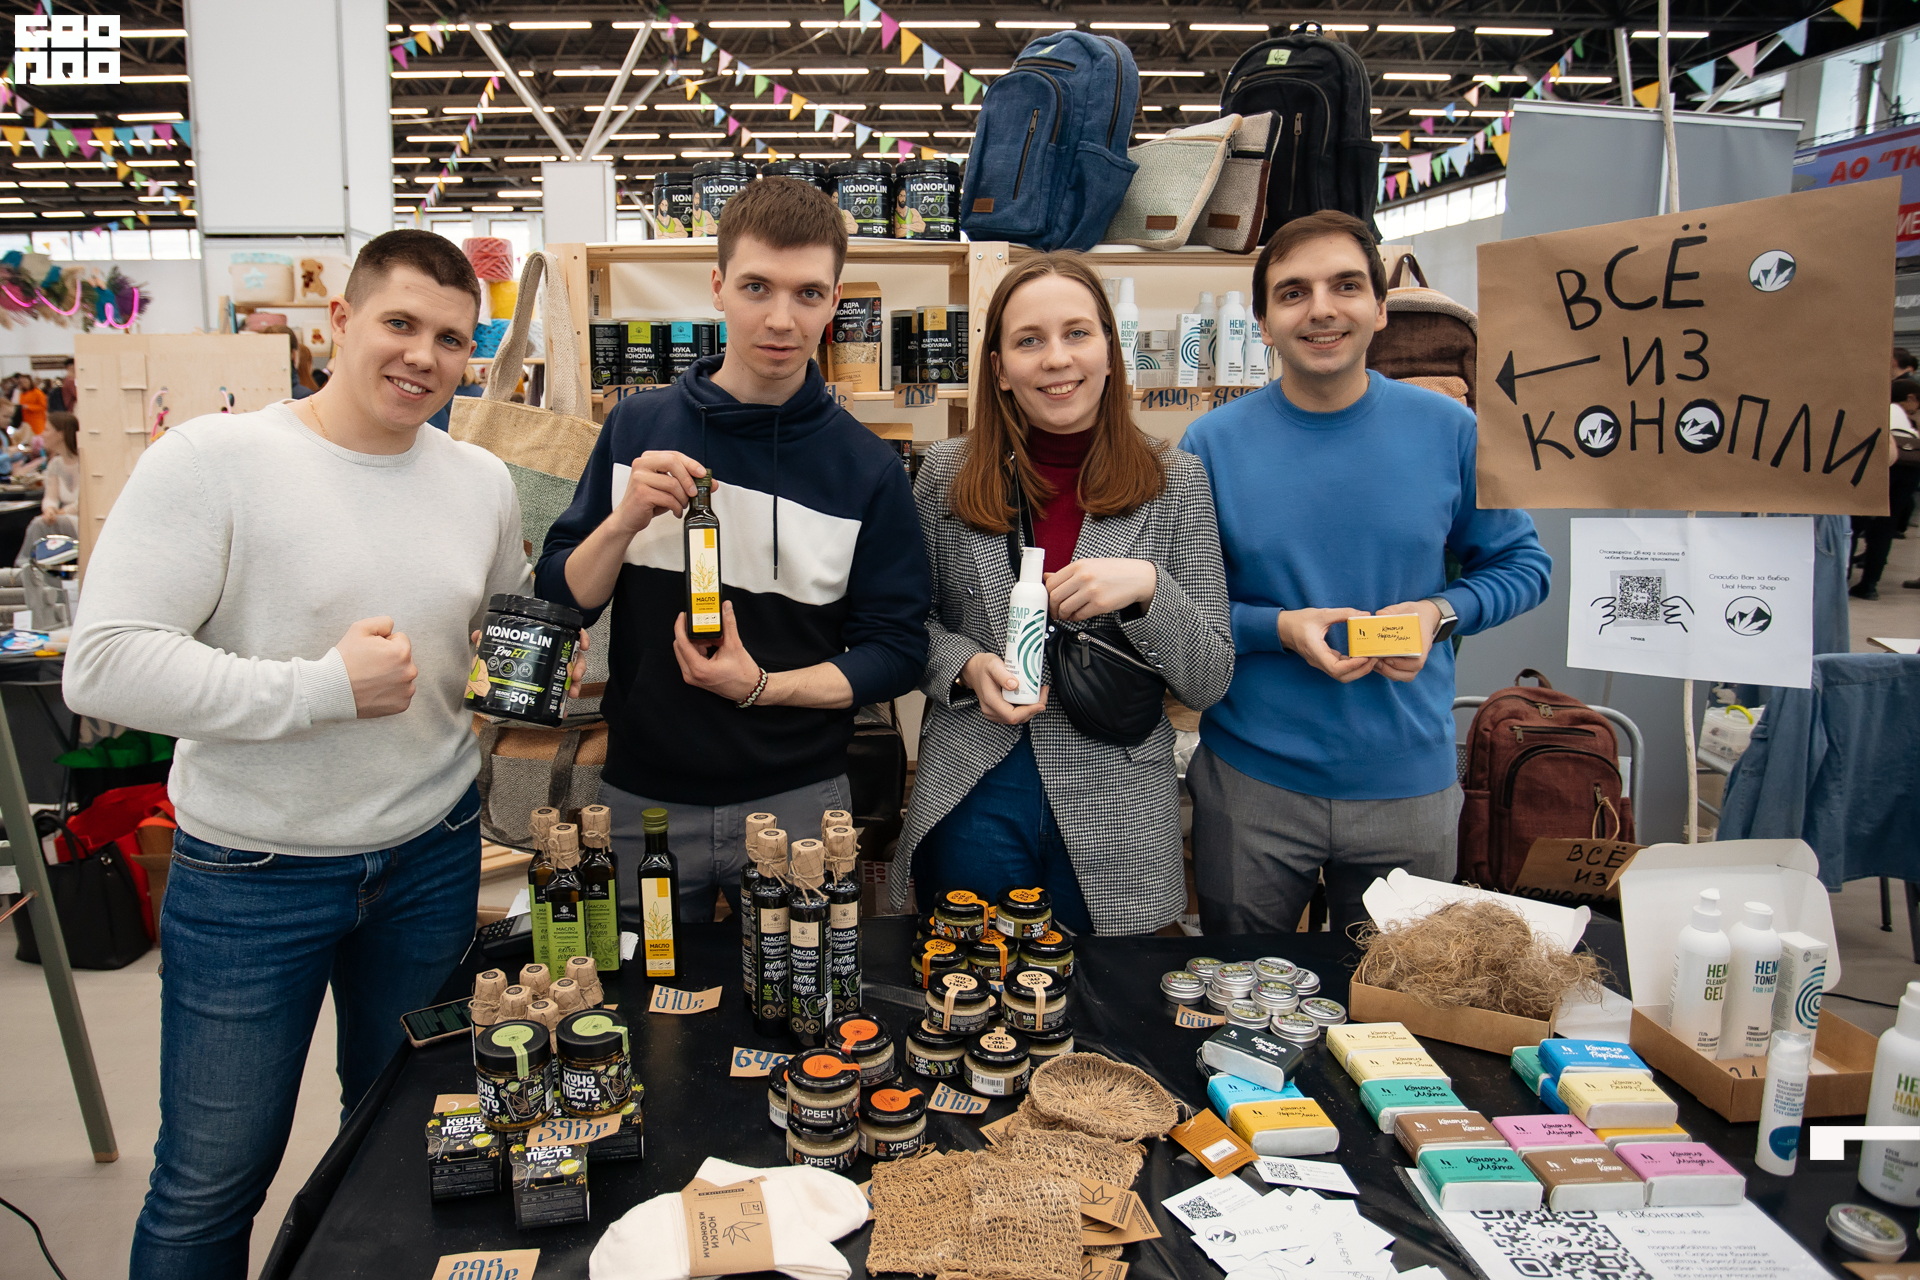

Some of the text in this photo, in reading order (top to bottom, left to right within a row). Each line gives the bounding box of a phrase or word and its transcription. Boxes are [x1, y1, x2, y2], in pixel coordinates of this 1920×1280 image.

[1828, 156, 1869, 184] АО
[842, 184, 888, 194] KONOPLIN
[910, 183, 955, 192] KONOPLIN
[1557, 223, 1708, 331] ВСЁ
[836, 308, 866, 316] КОНОПЛИ
[1121, 320, 1139, 330] HEMP
[1623, 329, 1709, 387] ИЗ
[1523, 394, 1881, 488] КОНОПЛИ
[1708, 573, 1739, 582] Спасибо
[1767, 574, 1790, 582] выбор
[1737, 584, 1757, 592] Hemp
[1759, 584, 1776, 592] Shop
[486, 625, 553, 648] KONOPLIN
[509, 691, 536, 706] 50%
[1566, 843, 1626, 869] ВСЁ
[1574, 869, 1608, 887] ИЗ
[832, 929, 856, 937] МАСЛО
[792, 948, 817, 956] МАСЛО
[1754, 975, 1777, 985] TONER
[1703, 986, 1724, 1001] GEL
[563, 1071, 596, 1089] КОНО
[527, 1084, 544, 1096] ЕДА
[562, 1083, 601, 1101] ПЕСТО
[800, 1108, 834, 1119] УРБЕЧ
[441, 1124, 486, 1136] ПЕСТО
[888, 1138, 919, 1152] УРБЕЧ
[526, 1148, 572, 1163] ПЕСТО
[803, 1156, 837, 1167] УРБЕЧ
[698, 1212, 711, 1259] ИЗ КОНОПЛИ
[708, 1216, 719, 1249] НОСКИ
[1238, 1223, 1289, 1237] URAL HEMP
[1338, 1247, 1353, 1266] HEMP
